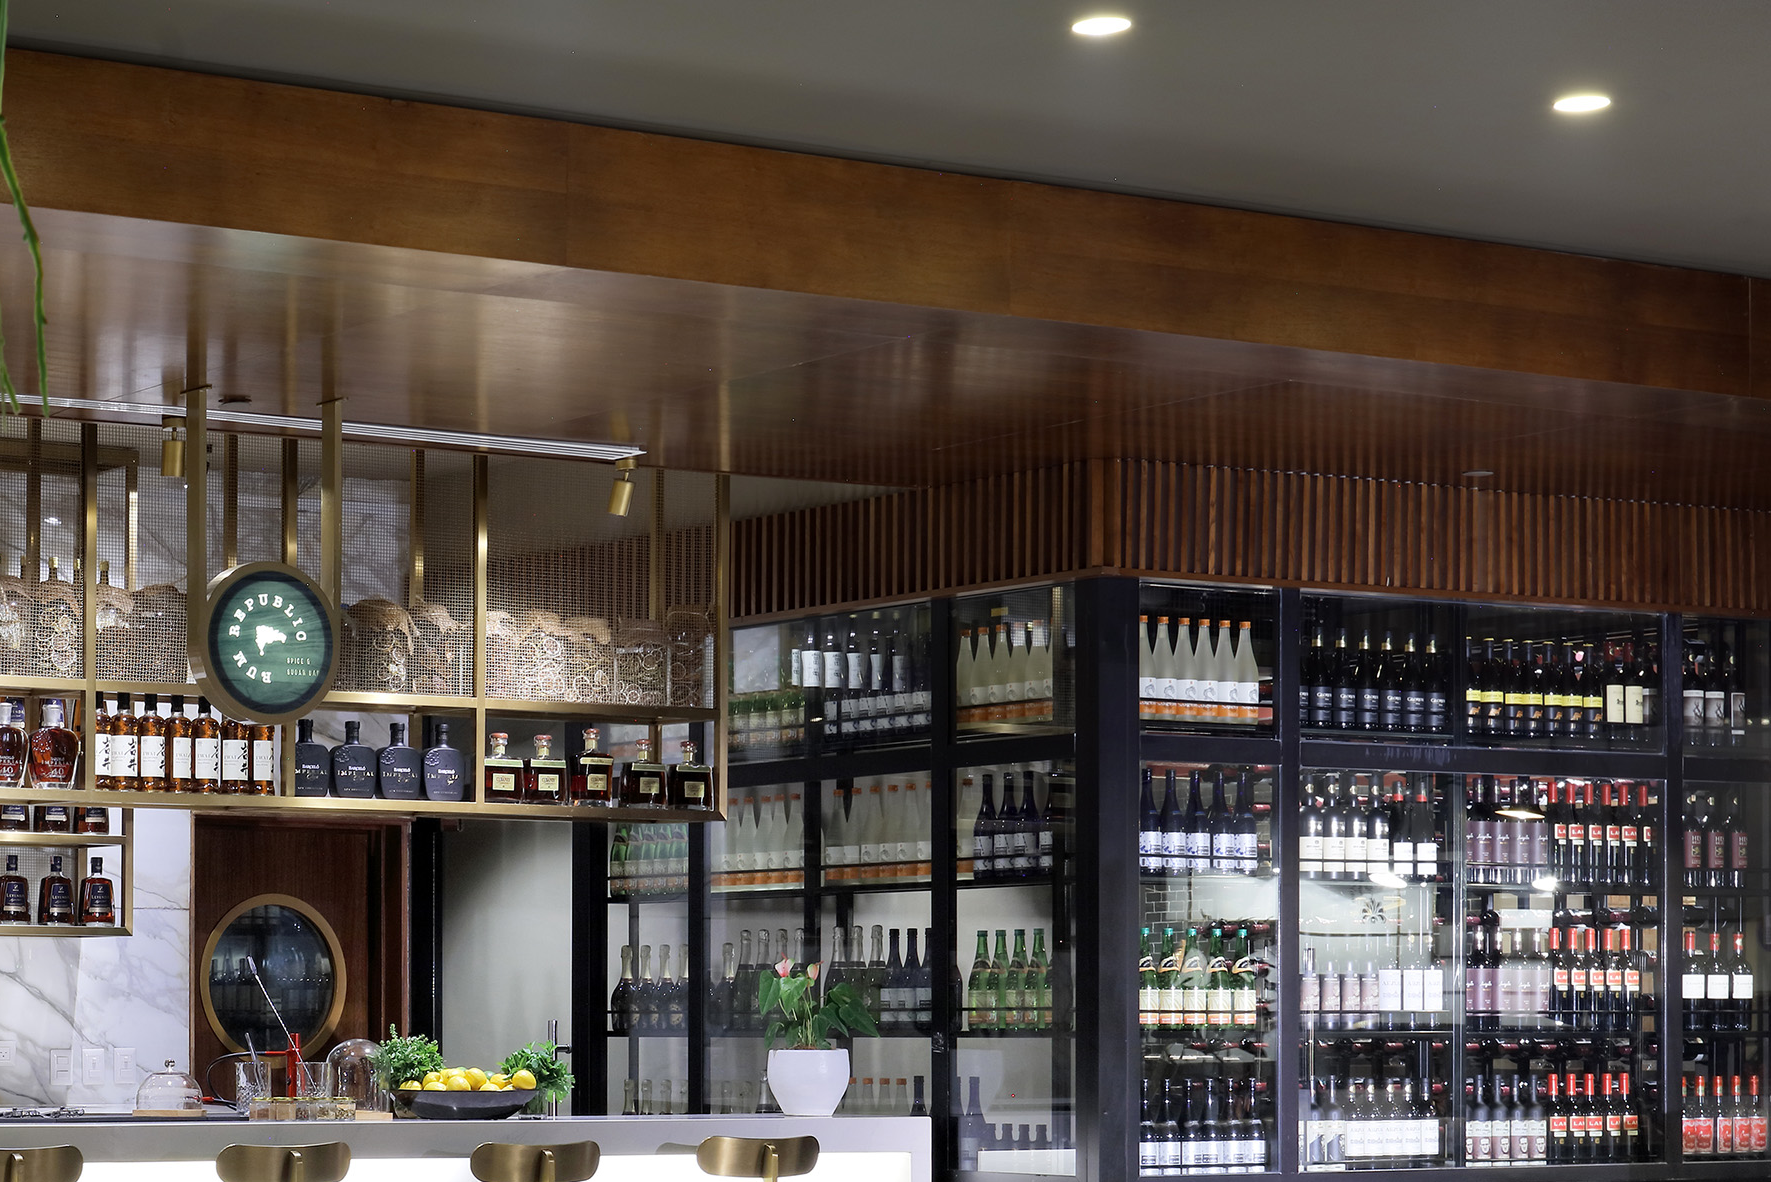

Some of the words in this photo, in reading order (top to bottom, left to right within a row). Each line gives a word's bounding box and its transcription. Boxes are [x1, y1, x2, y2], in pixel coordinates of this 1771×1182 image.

[286, 657, 304, 665] SPICE
[233, 651, 271, 684] RUM
[286, 668, 307, 676] SUGAR
